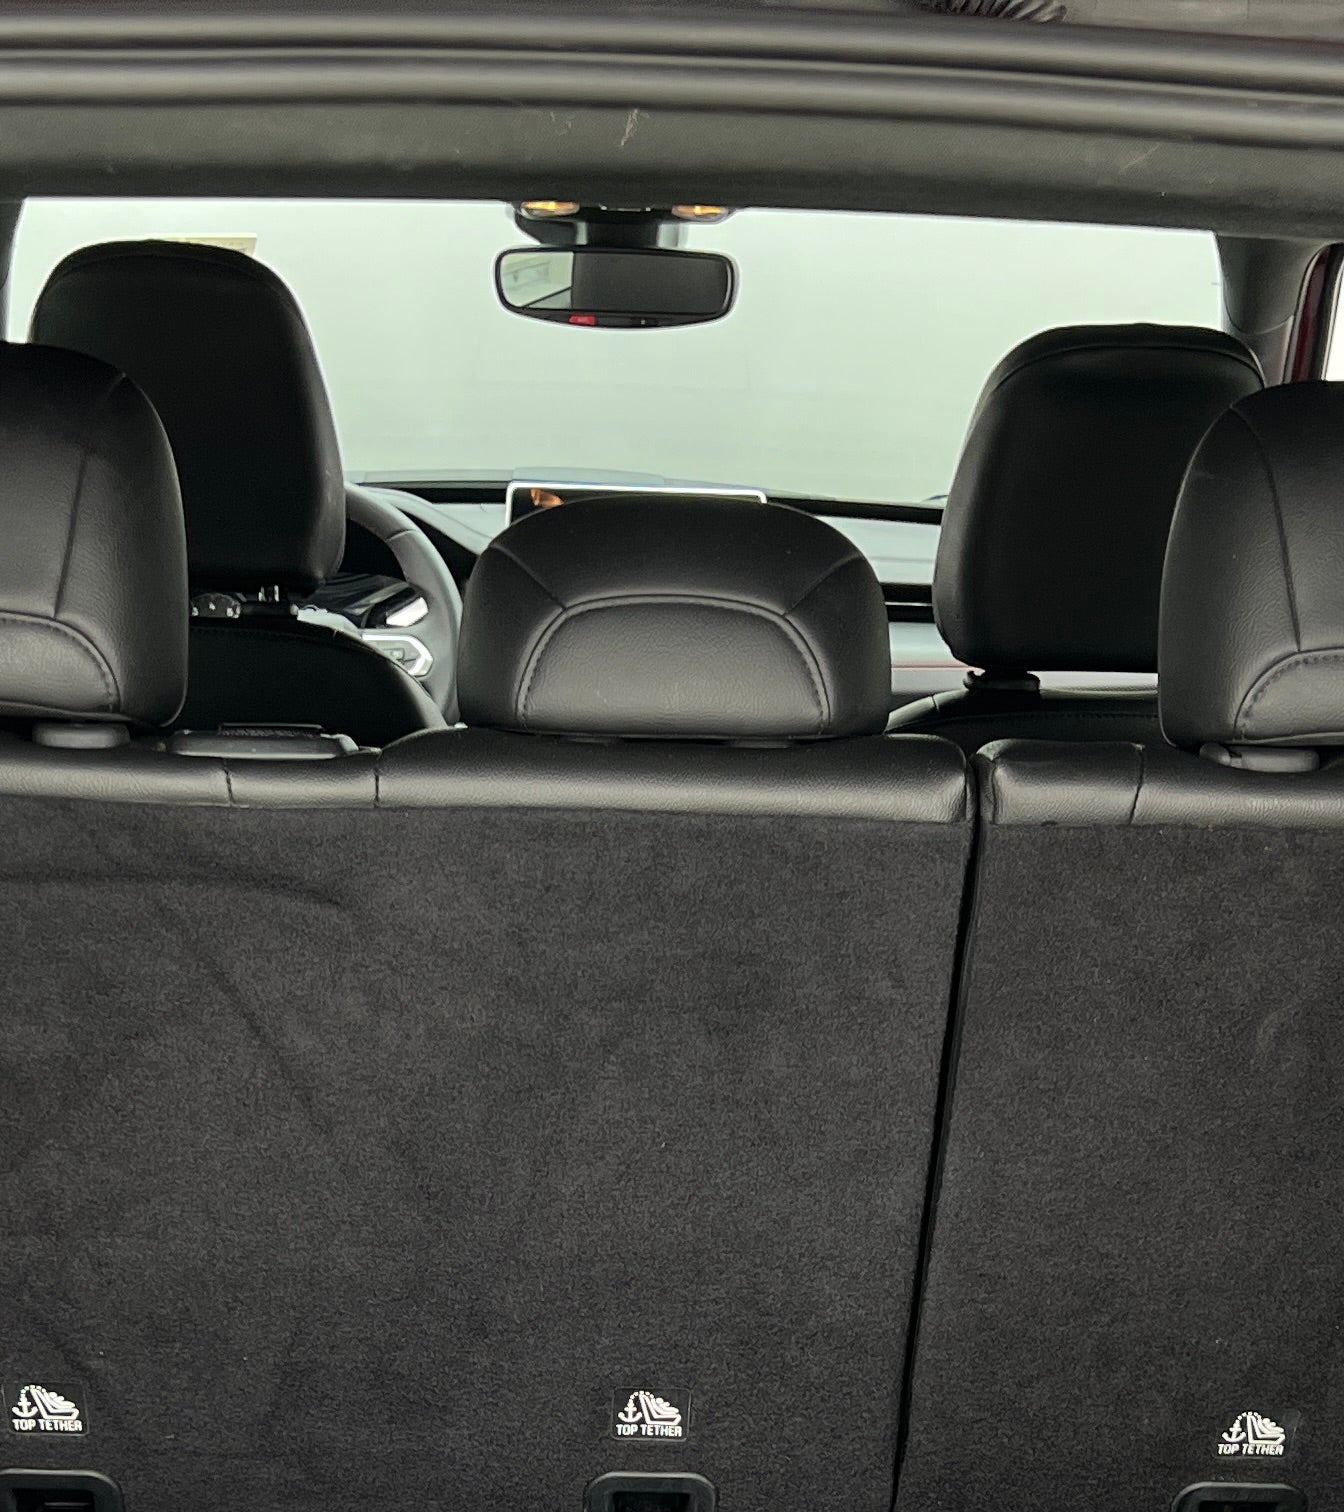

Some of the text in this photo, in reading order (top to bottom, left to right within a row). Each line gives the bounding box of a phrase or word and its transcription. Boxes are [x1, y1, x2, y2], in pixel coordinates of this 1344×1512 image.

[12, 1419, 82, 1431] TOP TETHER
[616, 1424, 682, 1437] TOP TETHER
[1217, 1444, 1284, 1455] TOP TETHER
